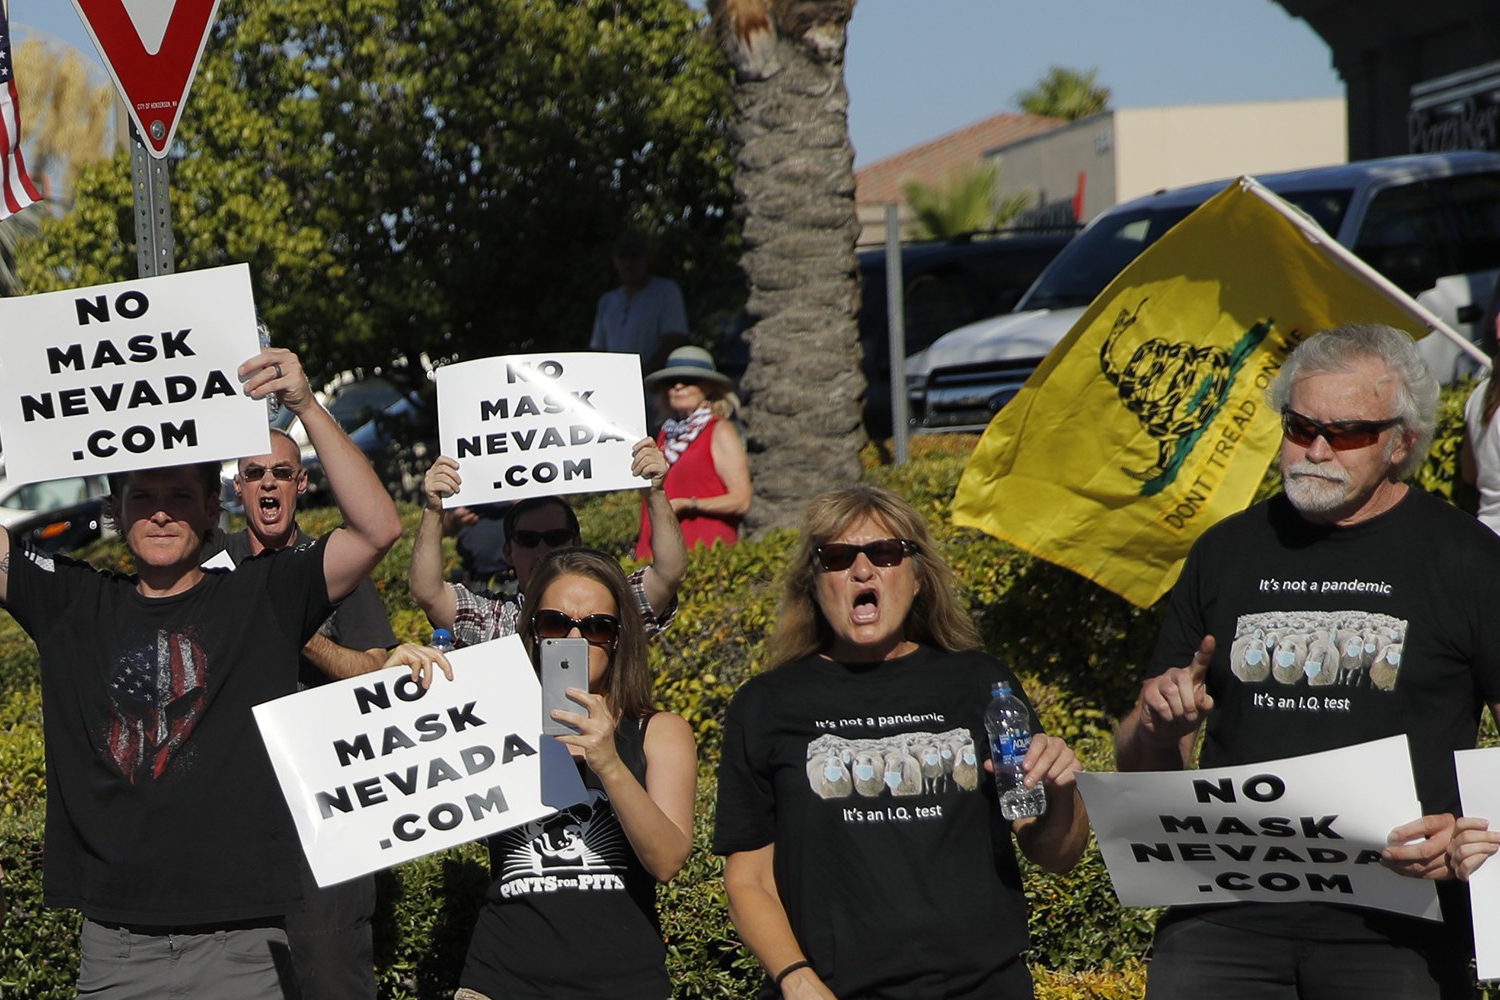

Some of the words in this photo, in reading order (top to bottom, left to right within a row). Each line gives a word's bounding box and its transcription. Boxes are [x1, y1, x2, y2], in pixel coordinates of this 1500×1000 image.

[74, 290, 149, 326] NO
[46, 328, 196, 375] MASK
[506, 360, 564, 384] NO
[20, 369, 236, 422] NEVADA
[480, 390, 596, 422] MASK
[1206, 400, 1256, 468] TREAD
[1255, 358, 1281, 390] ON
[72, 419, 199, 461] .COM
[457, 422, 626, 459] NEVADA
[493, 458, 592, 490] .COM
[1259, 578, 1280, 591] It's
[1282, 580, 1308, 592] not
[1310, 582, 1318, 592] a
[1321, 578, 1393, 594] pandemic
[353, 673, 427, 717] NO
[1254, 693, 1274, 708] It's
[1278, 698, 1295, 708] an
[1298, 697, 1321, 710] I.Q.
[1324, 696, 1350, 710] test
[332, 700, 487, 768] MASK
[815, 720, 837, 730] It's
[840, 717, 864, 728] not
[867, 717, 876, 726] a
[878, 712, 945, 728] pandemic
[314, 733, 538, 820] NEVADA
[1192, 773, 1286, 804] NO
[378, 785, 509, 850] .COM
[843, 808, 864, 822] It's
[866, 810, 884, 821] an
[887, 806, 912, 820] I.Q.
[915, 804, 943, 818] test
[1158, 814, 1344, 840] MASK
[1130, 842, 1384, 865] NEVADA
[500, 875, 558, 898] PINTS
[578, 874, 625, 890] PITS
[1197, 871, 1354, 895] .COM
